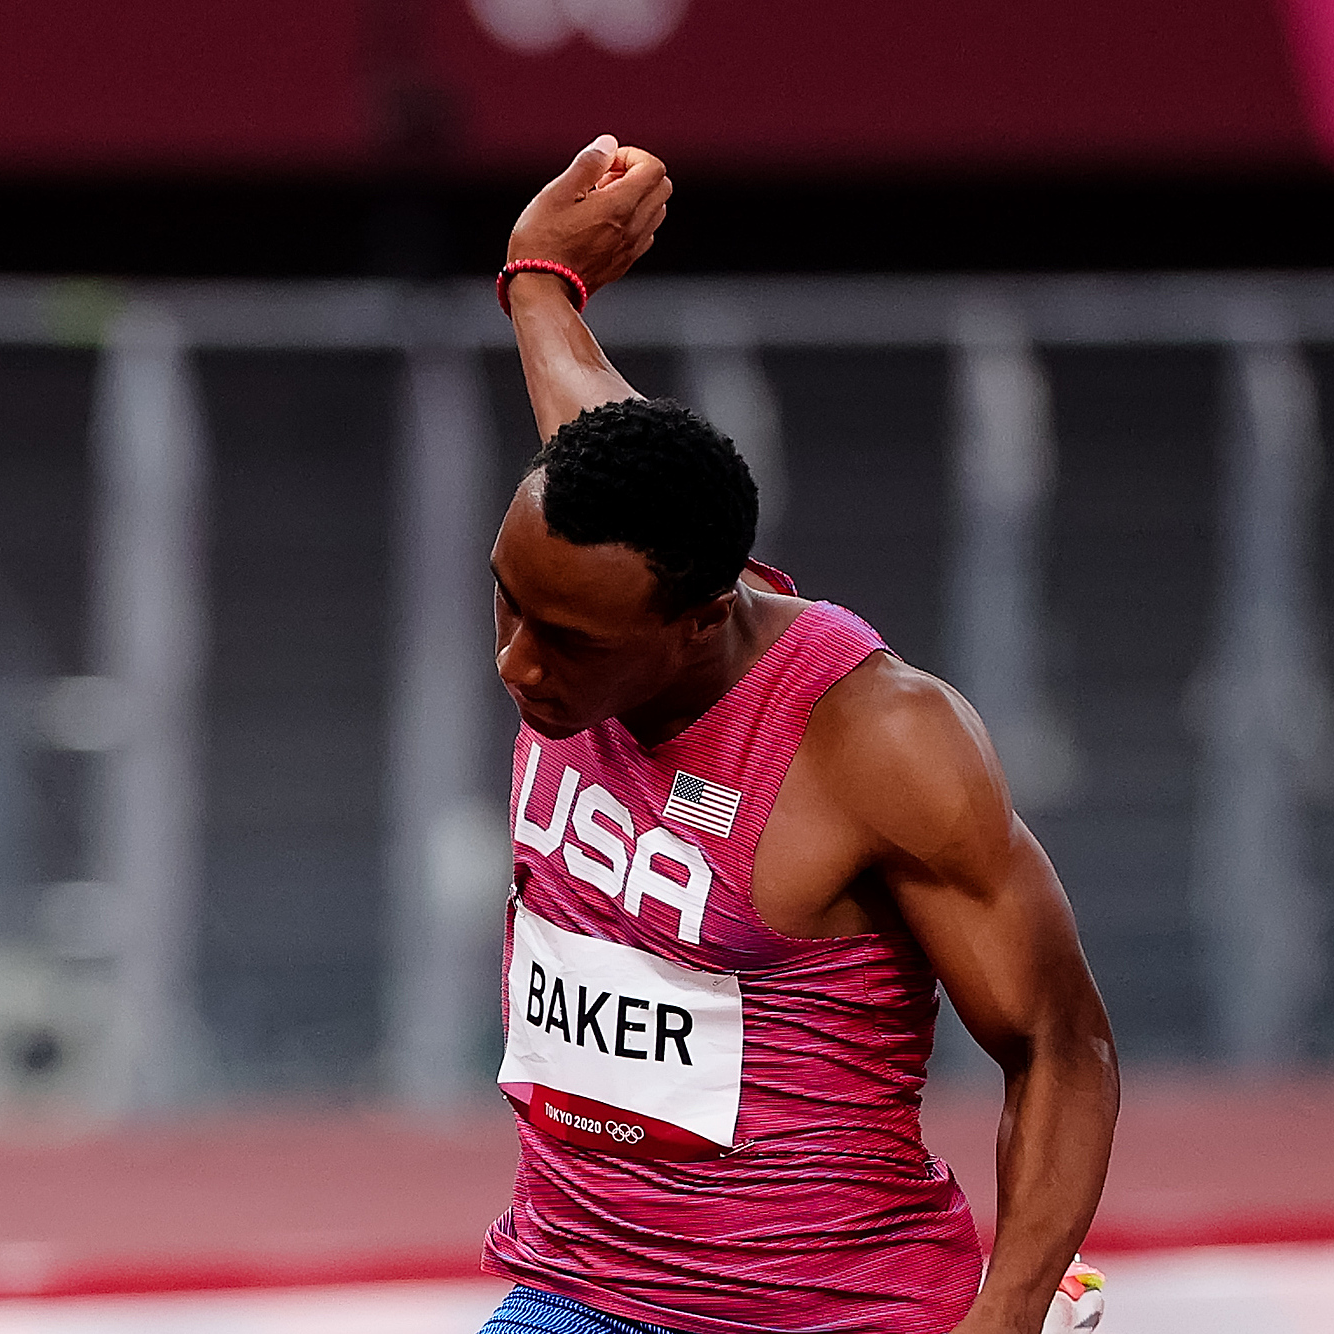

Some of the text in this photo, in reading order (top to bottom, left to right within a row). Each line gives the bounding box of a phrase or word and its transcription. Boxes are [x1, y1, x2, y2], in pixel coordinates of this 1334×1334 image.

[514, 741, 713, 945] USA
[526, 960, 694, 1066] BAKER
[545, 1102, 602, 1134] TOKYO 2020
